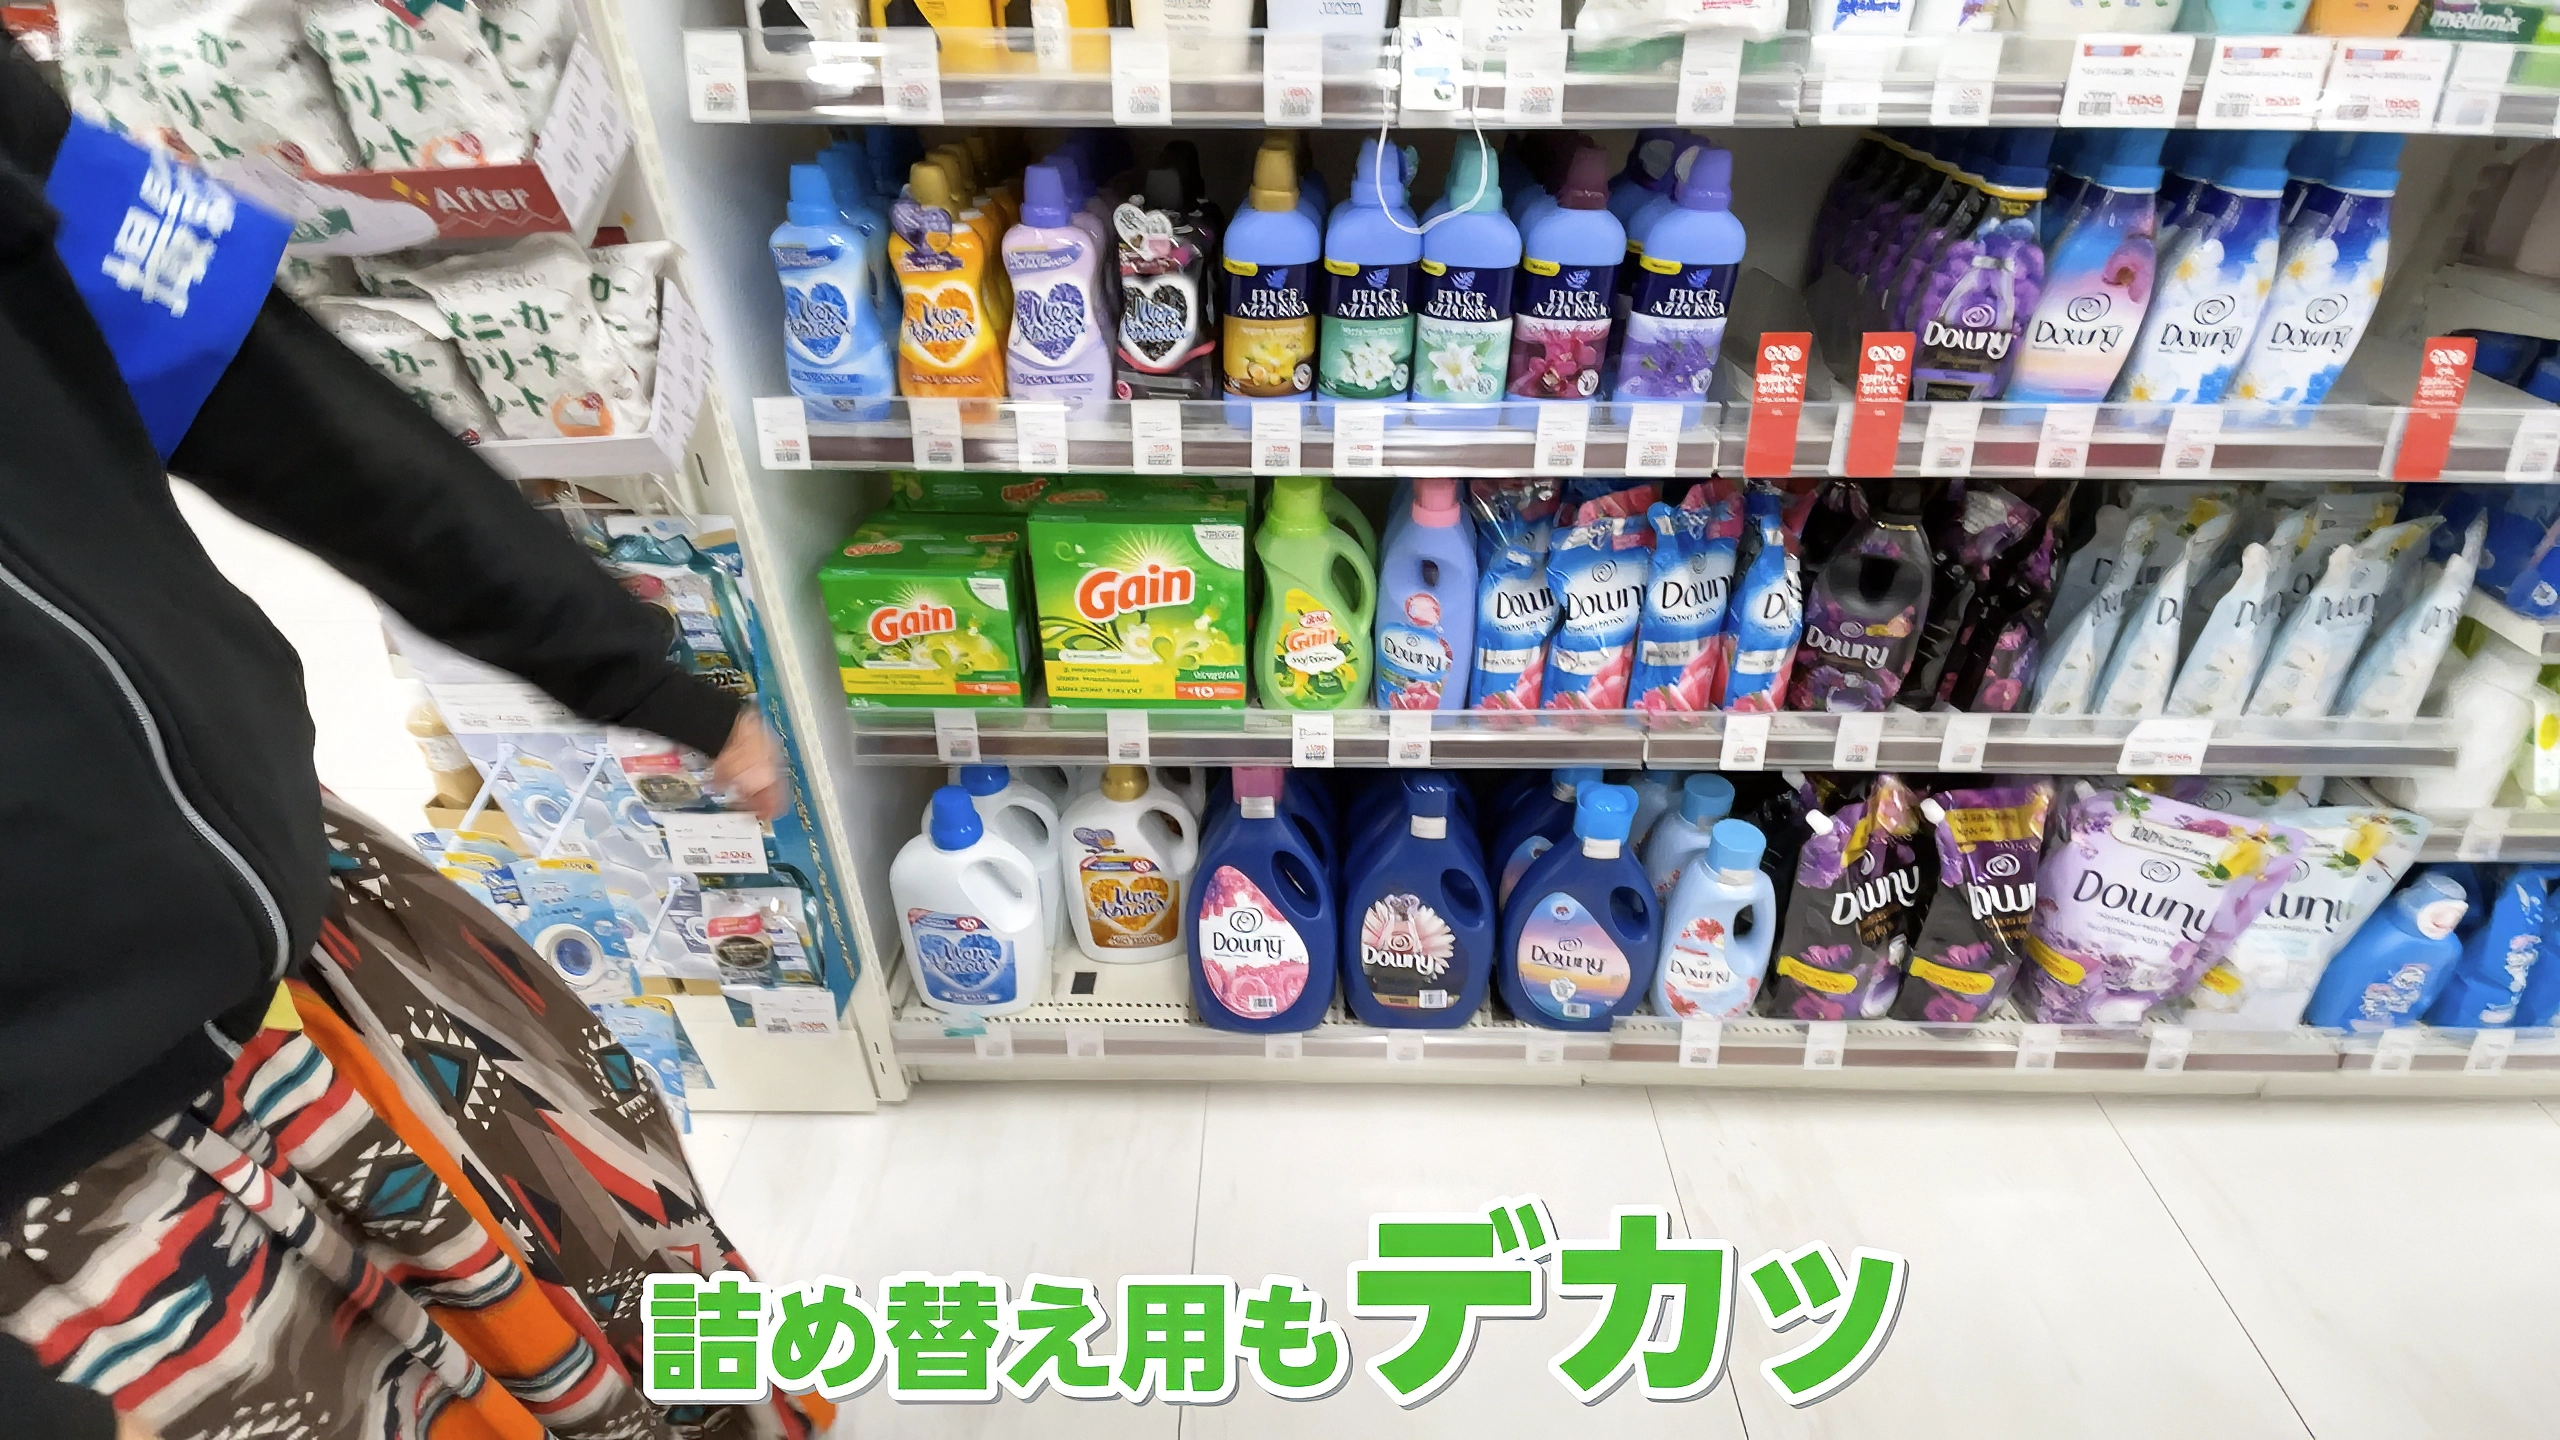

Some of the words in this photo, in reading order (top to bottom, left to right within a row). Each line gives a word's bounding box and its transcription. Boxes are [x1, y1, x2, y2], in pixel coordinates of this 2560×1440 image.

[434, 186, 530, 213] After
[1923, 320, 2013, 360] Downy
[1079, 564, 1191, 619] Gain
[871, 605, 953, 643] Gain
[1384, 636, 1443, 673] Downy
[1806, 624, 1890, 669] Downy
[1831, 866, 1920, 925] Dwny
[2072, 870, 2209, 943] Downy
[1213, 931, 1284, 958] Downy
[1362, 945, 1434, 975] Downy
[1531, 944, 1606, 975] Downy
